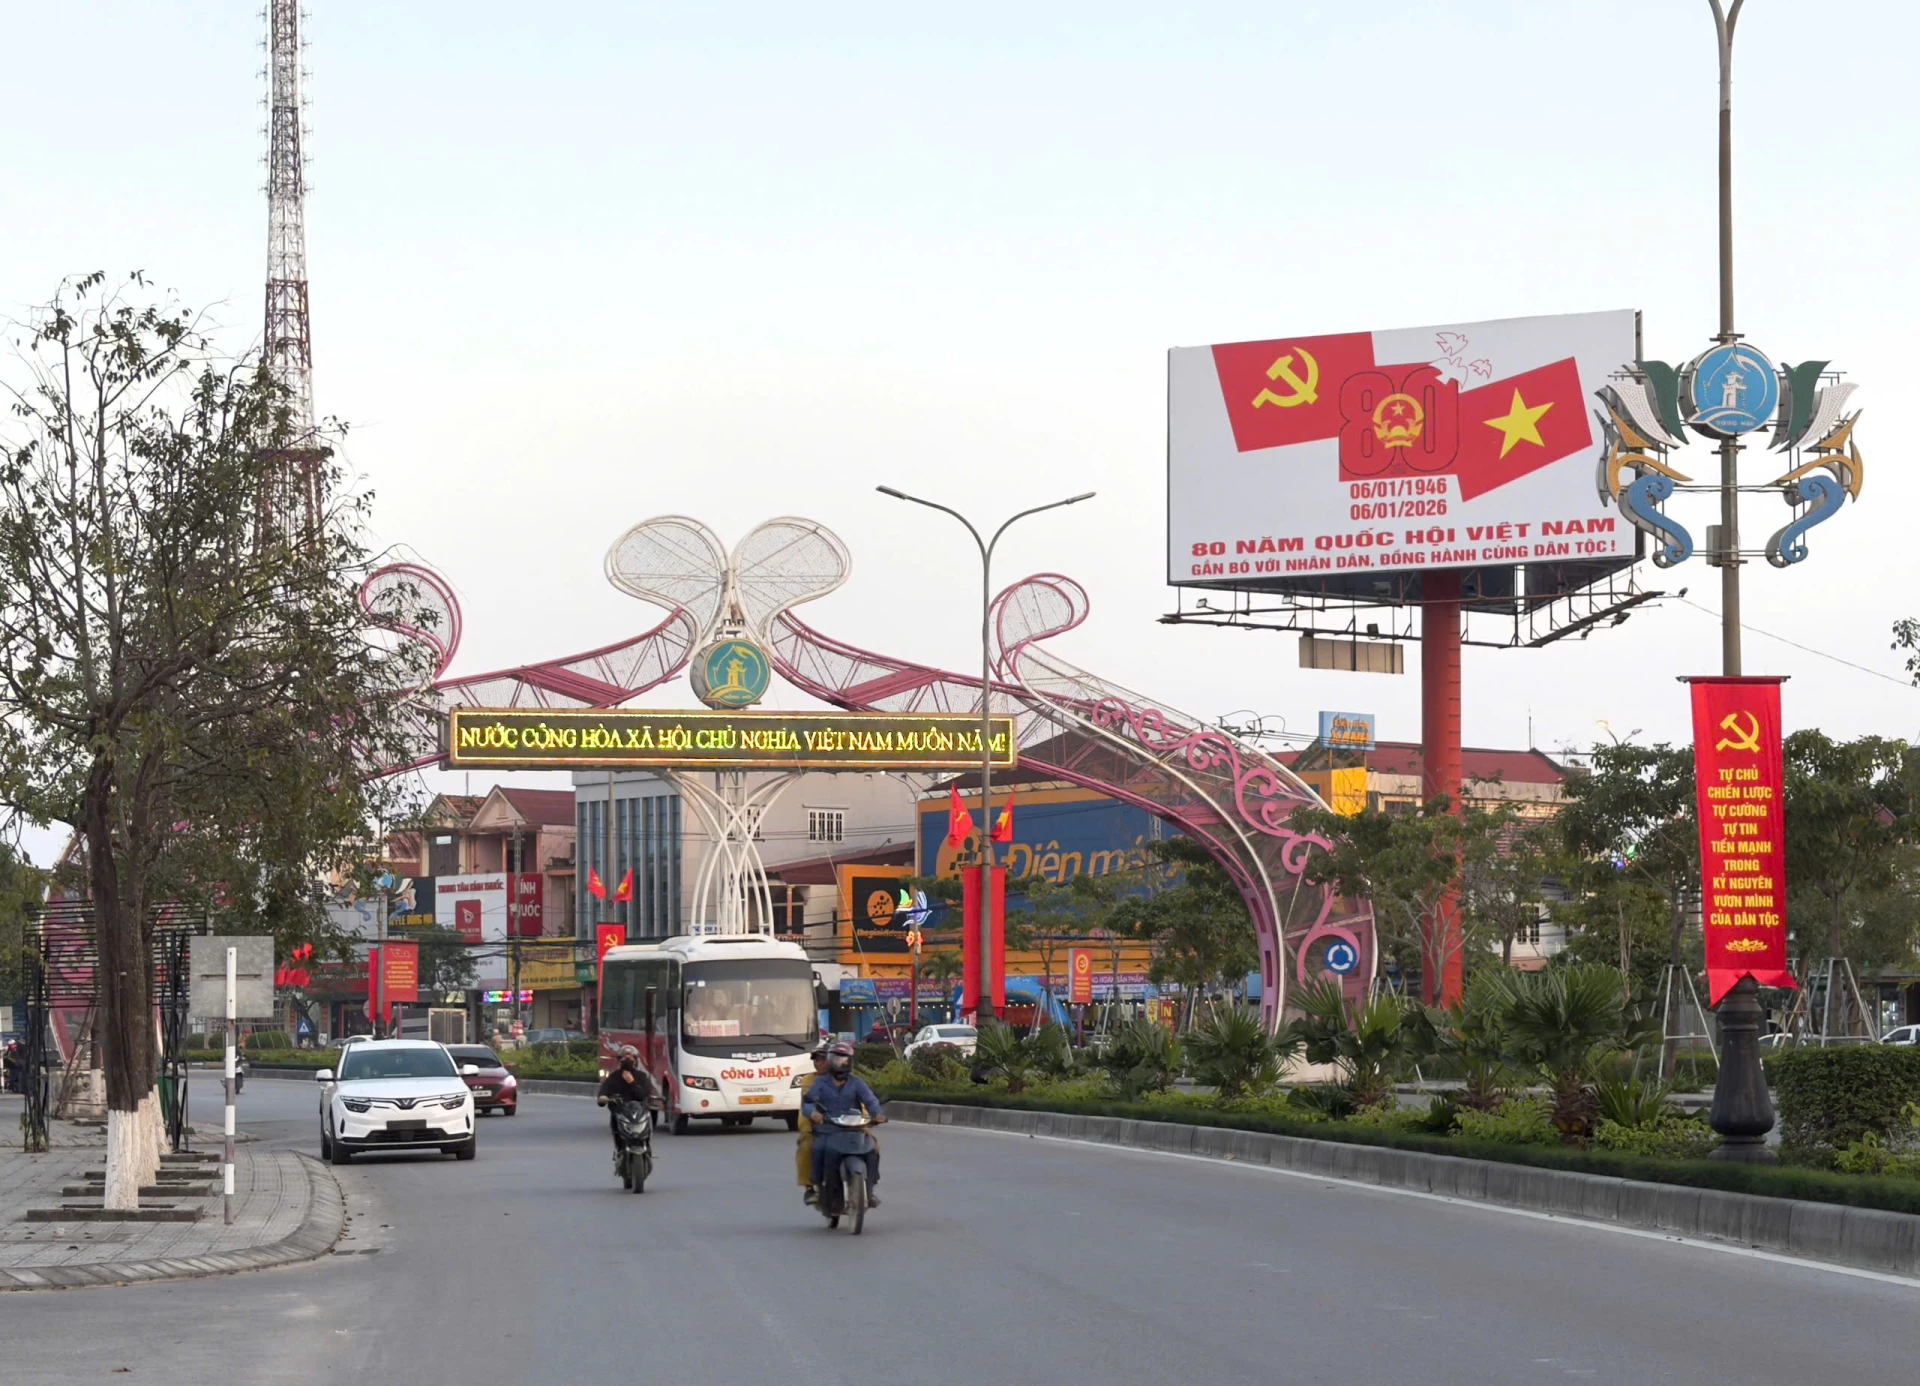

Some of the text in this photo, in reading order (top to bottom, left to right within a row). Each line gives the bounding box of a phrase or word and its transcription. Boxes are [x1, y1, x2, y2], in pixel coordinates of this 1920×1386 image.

[1350, 478, 1447, 499] 06/01/1946
[1350, 499, 1447, 520] 06/01/2026
[1192, 518, 1615, 557] 80 NĂM QUỐC HỘI VIỆT NAM
[1229, 559, 1250, 574] BÓ
[1255, 558, 1280, 573] VỚI
[1286, 556, 1331, 571] NHÂN
[1336, 553, 1375, 568] DÂN,
[1380, 549, 1425, 565] ĐỒNG
[1430, 547, 1477, 563] HÀNH
[1482, 545, 1528, 560] CÙNG
[1534, 540, 1569, 556] DÂN
[460, 722, 519, 748] NƯỚC
[521, 722, 577, 749] CỘNG
[580, 723, 624, 748] HÒA
[657, 724, 694, 750] HỘI
[695, 725, 737, 749] CHỦ
[803, 727, 846, 751] VIỆT
[848, 731, 893, 751] NAM
[896, 726, 953, 751] MUÔN
[1718, 764, 1759, 783] TỰ CHỦ
[1708, 783, 1773, 801] CHIẾN LƯỢC
[1712, 802, 1767, 819] TỰ CƯỜNG
[1723, 822, 1758, 837] TỰ TIN
[1711, 837, 1772, 855] TIẾN MẠNH
[1723, 859, 1760, 871] TRONG
[517, 878, 536, 894] ÍNH
[1713, 872, 1773, 889] KỶ NGUYÊN
[509, 900, 541, 917] TUỐC
[1713, 893, 1774, 908] VƯƠN MÌNH
[1710, 908, 1779, 928] CỦA DÂN TỘC
[720, 1065, 791, 1080] CÔNG NHẬT
